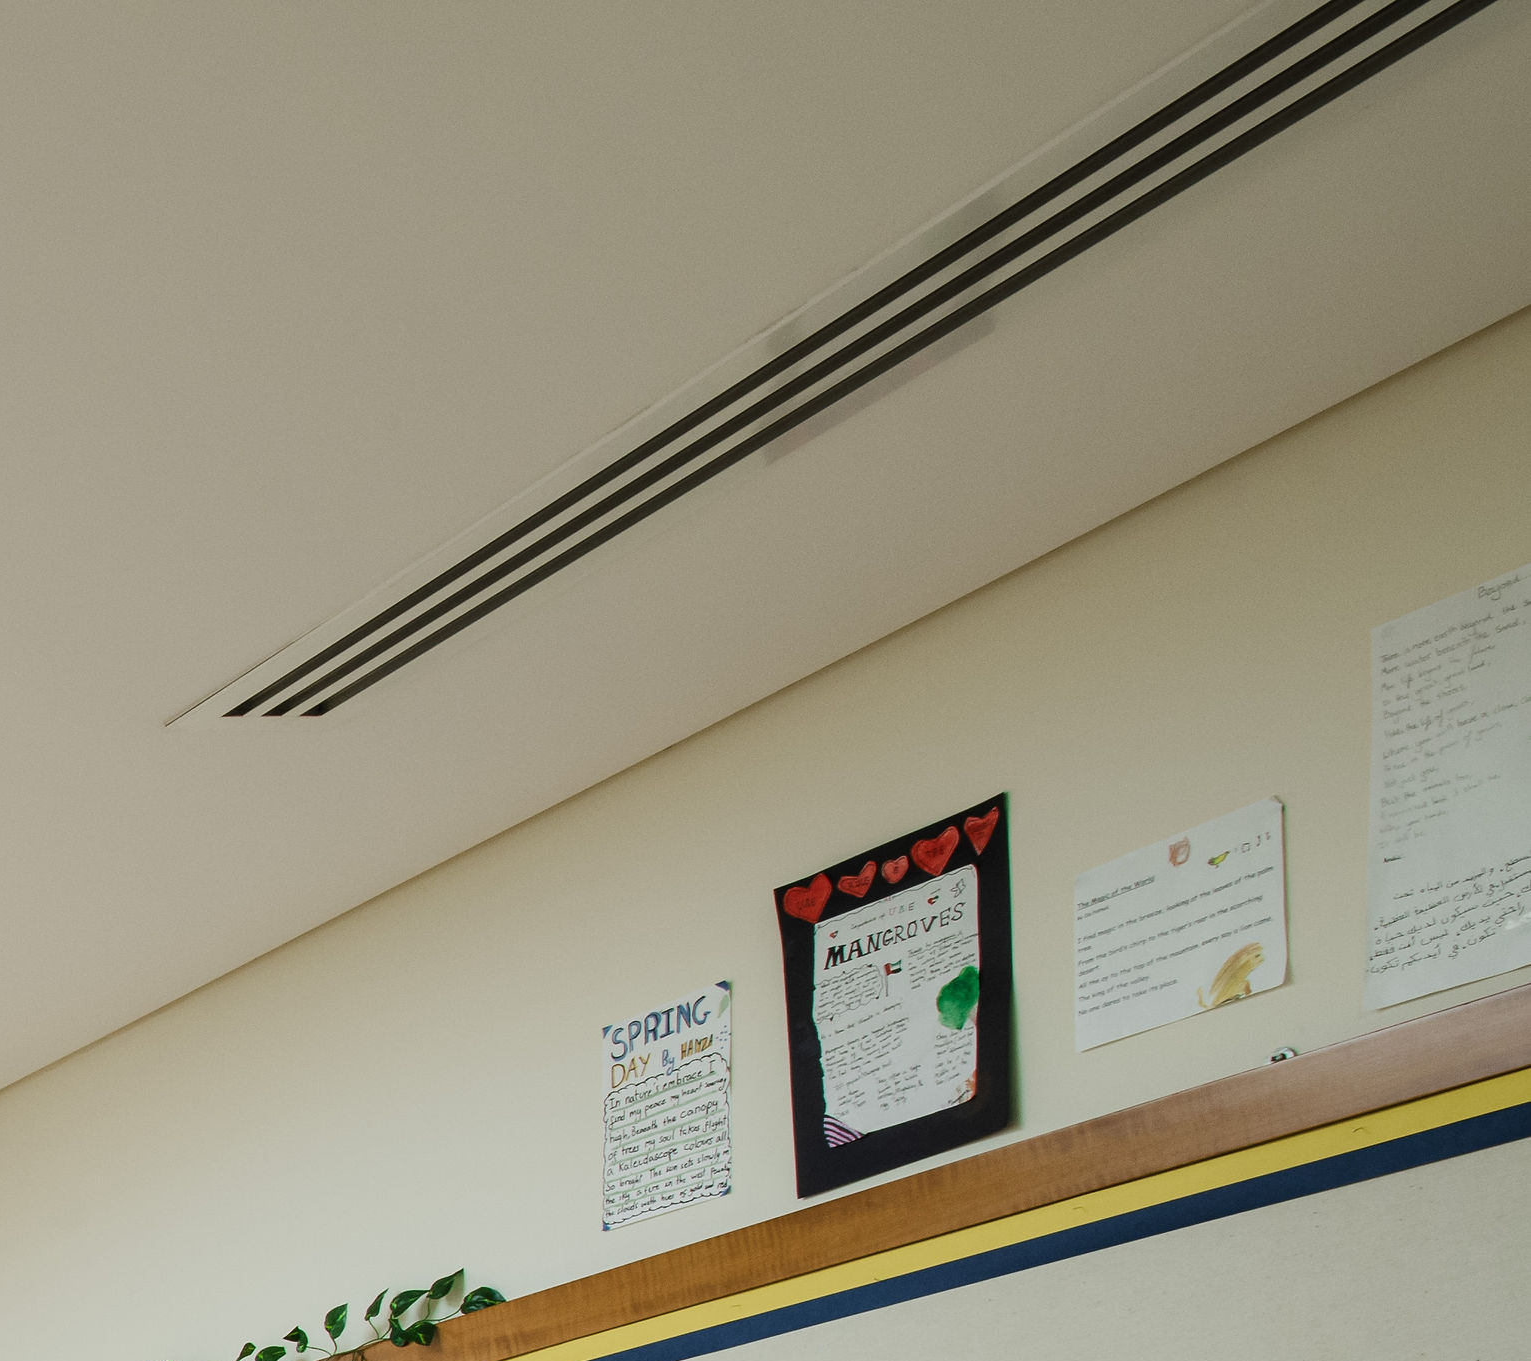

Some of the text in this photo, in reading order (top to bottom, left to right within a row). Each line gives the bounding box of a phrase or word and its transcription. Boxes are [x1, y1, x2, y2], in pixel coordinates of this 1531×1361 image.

[823, 902, 966, 971] MANGROVES
[610, 995, 711, 1062] SPRING
[609, 1097, 621, 1110] In
[663, 1069, 703, 1093] embrace
[612, 1053, 651, 1089] DAY
[662, 1049, 675, 1075] By
[630, 1107, 642, 1121] my
[645, 1097, 667, 1117] peace
